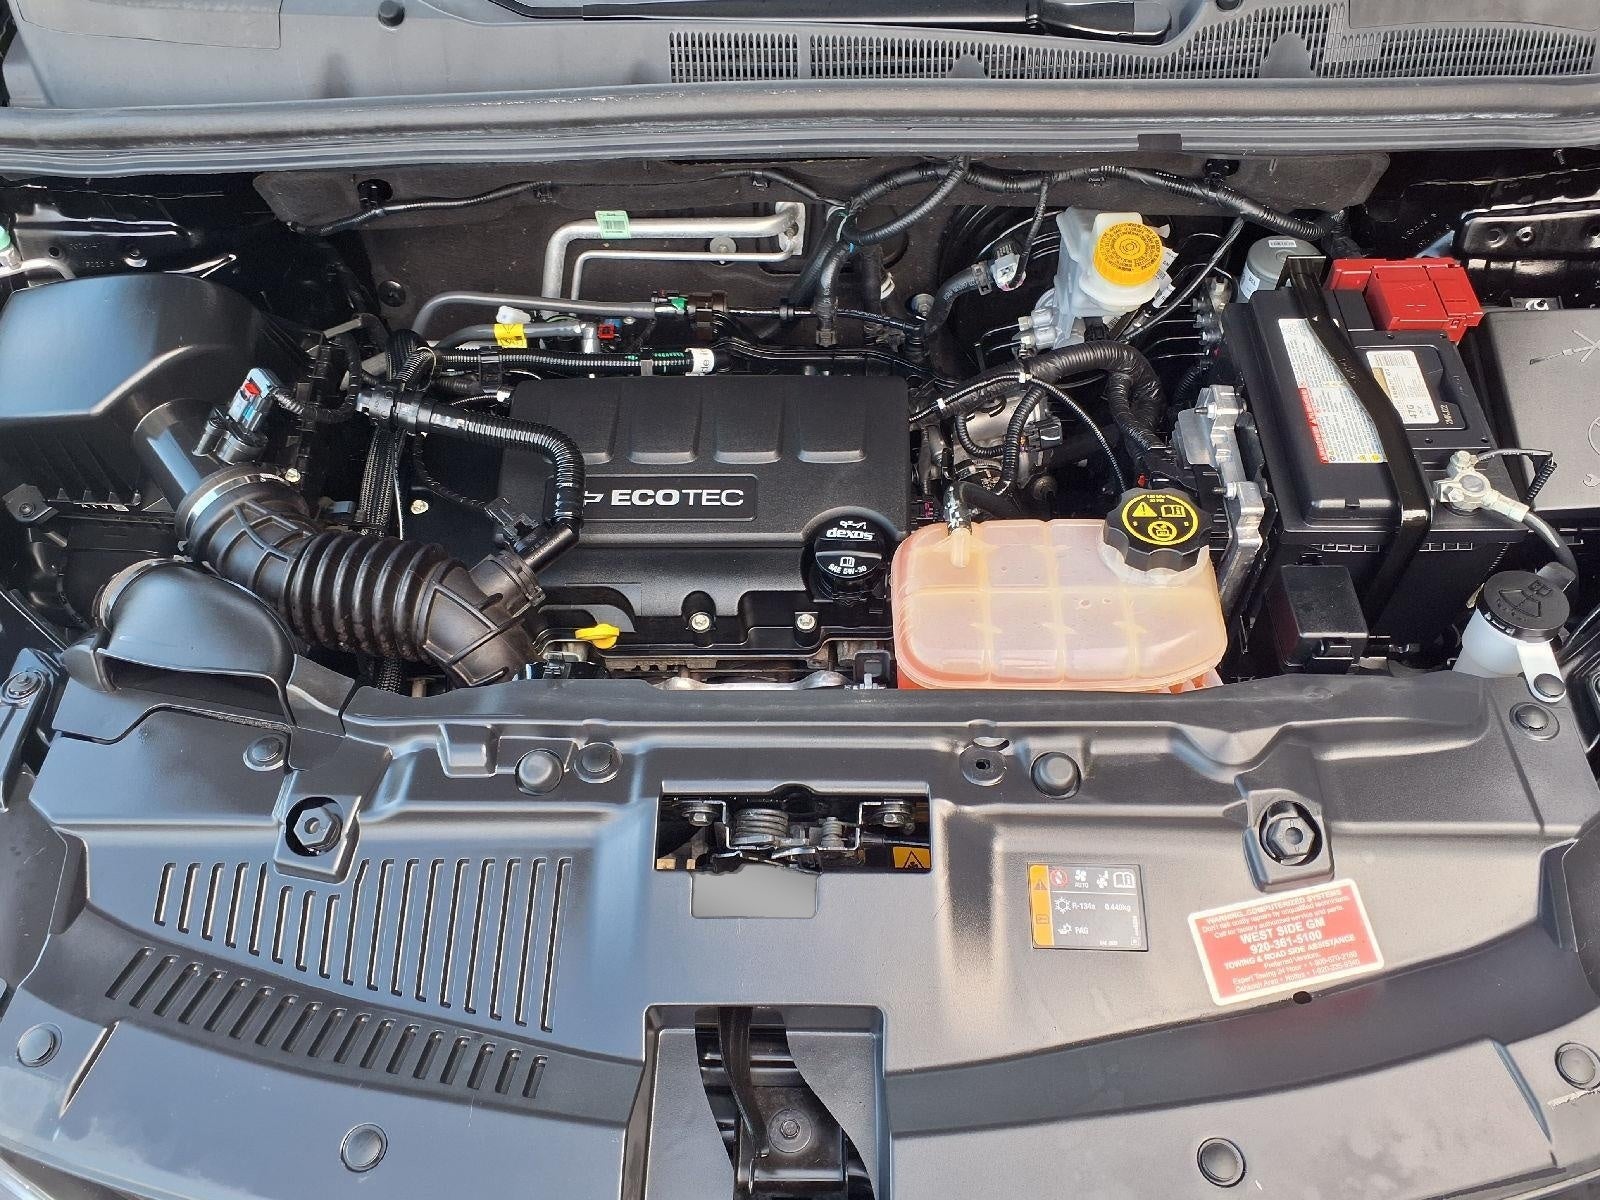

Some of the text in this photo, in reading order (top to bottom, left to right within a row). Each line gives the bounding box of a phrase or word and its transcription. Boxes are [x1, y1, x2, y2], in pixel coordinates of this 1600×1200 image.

[611, 489, 744, 506] ECOTEC
[826, 527, 875, 540] dexos
[828, 563, 867, 575] SAE 5W-30
[1306, 889, 1341, 901] SYSTEMS
[1072, 902, 1096, 910] R-134a
[1258, 916, 1290, 928] authorized
[1291, 911, 1312, 920] service
[1074, 927, 1089, 935] PAG
[1240, 916, 1325, 944] WEST SIDE GM
[1225, 957, 1255, 969] TOWING
[1264, 949, 1286, 960] ROAD
[1287, 945, 1305, 954] SIDE
[1307, 933, 1355, 949] ASSISTANCE
[1264, 957, 1292, 968] Preferred
[1233, 975, 1253, 985] Expert
[1255, 969, 1276, 979] Towing
[1286, 963, 1301, 972] Hour
[1263, 977, 1278, 986] Area
